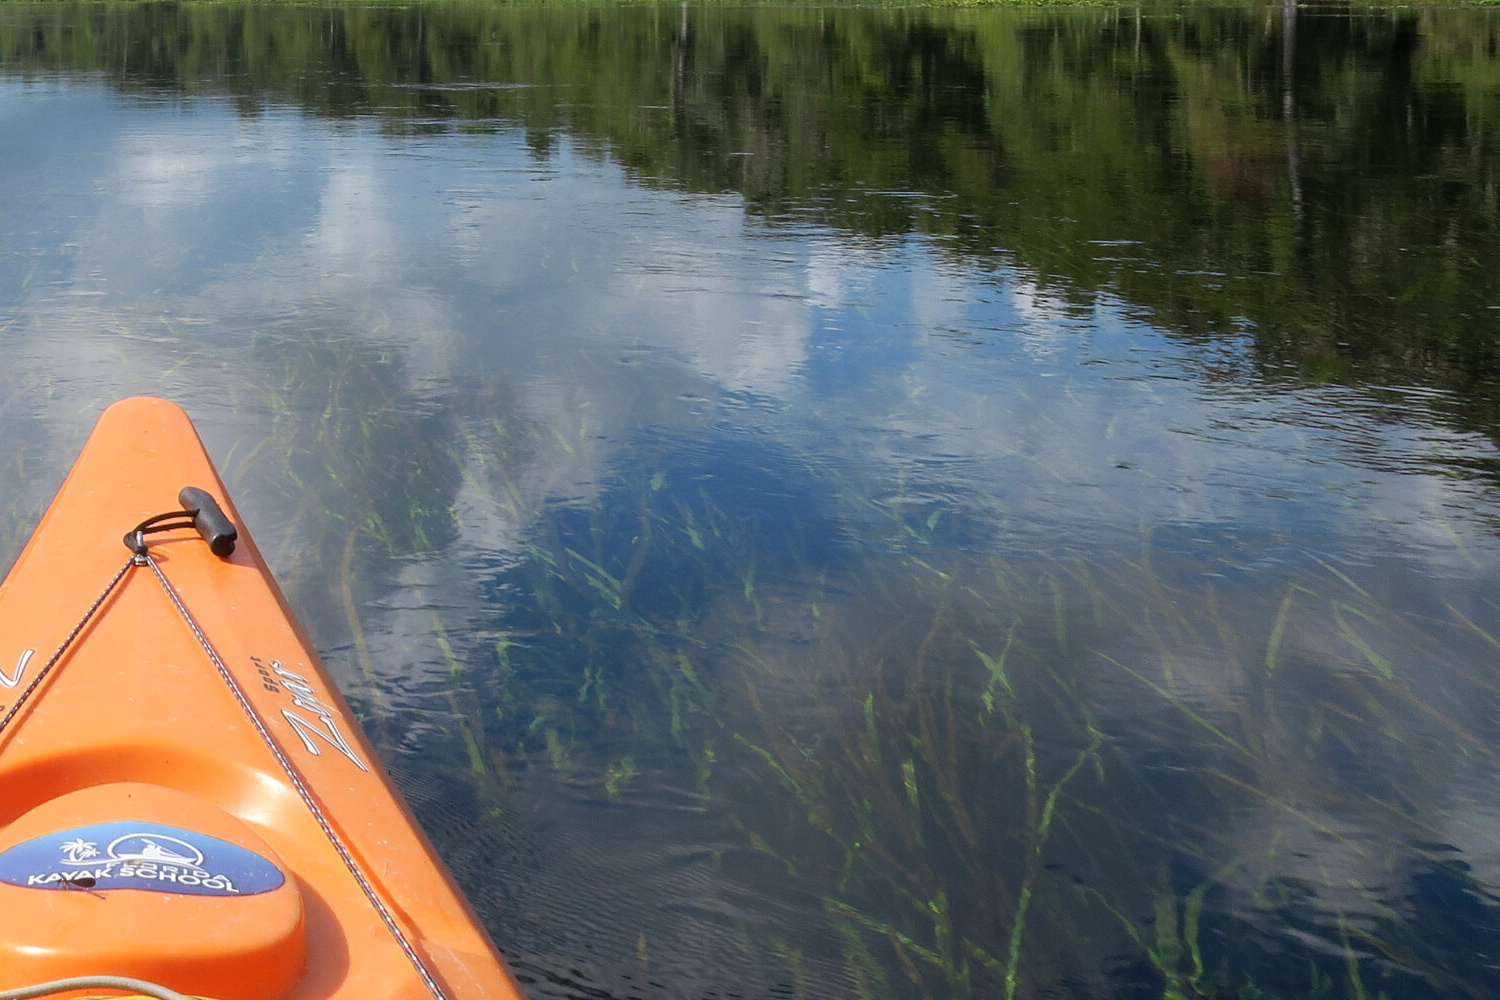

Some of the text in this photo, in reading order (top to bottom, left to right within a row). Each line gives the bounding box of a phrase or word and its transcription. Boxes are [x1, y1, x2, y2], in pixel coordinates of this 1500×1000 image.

[249, 656, 280, 693] Sport
[28, 866, 240, 893] KAYAK SCHOOL
[106, 860, 230, 881] FLORIDA
